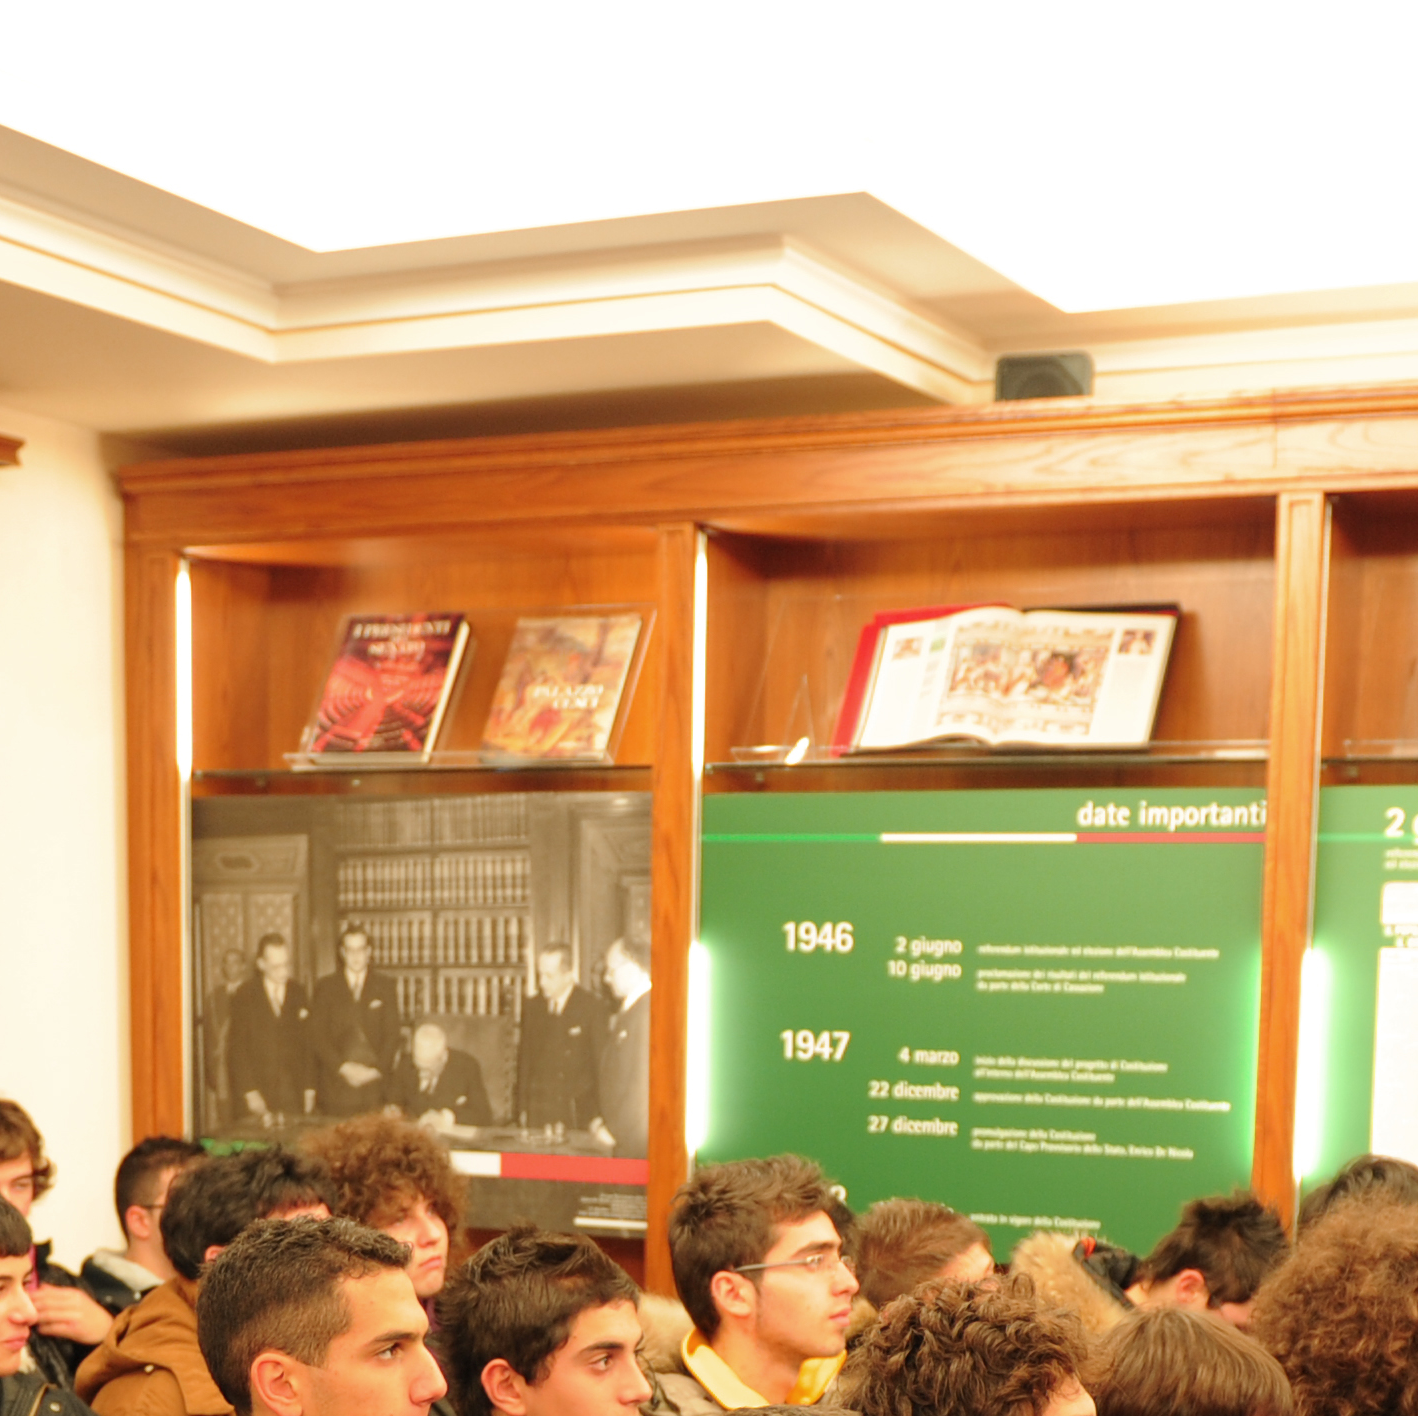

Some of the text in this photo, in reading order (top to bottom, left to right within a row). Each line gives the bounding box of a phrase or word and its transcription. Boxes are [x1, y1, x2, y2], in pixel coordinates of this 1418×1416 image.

[1078, 800, 1267, 832] date importanti
[1385, 807, 1406, 838] 2
[782, 921, 963, 960] 1946 2 giugno
[888, 960, 962, 984] 10 giugno
[781, 1030, 959, 1067] 1947 4 marzo
[868, 1080, 960, 1102] 22 dicembre
[868, 1115, 959, 1138] 27 dicembre
